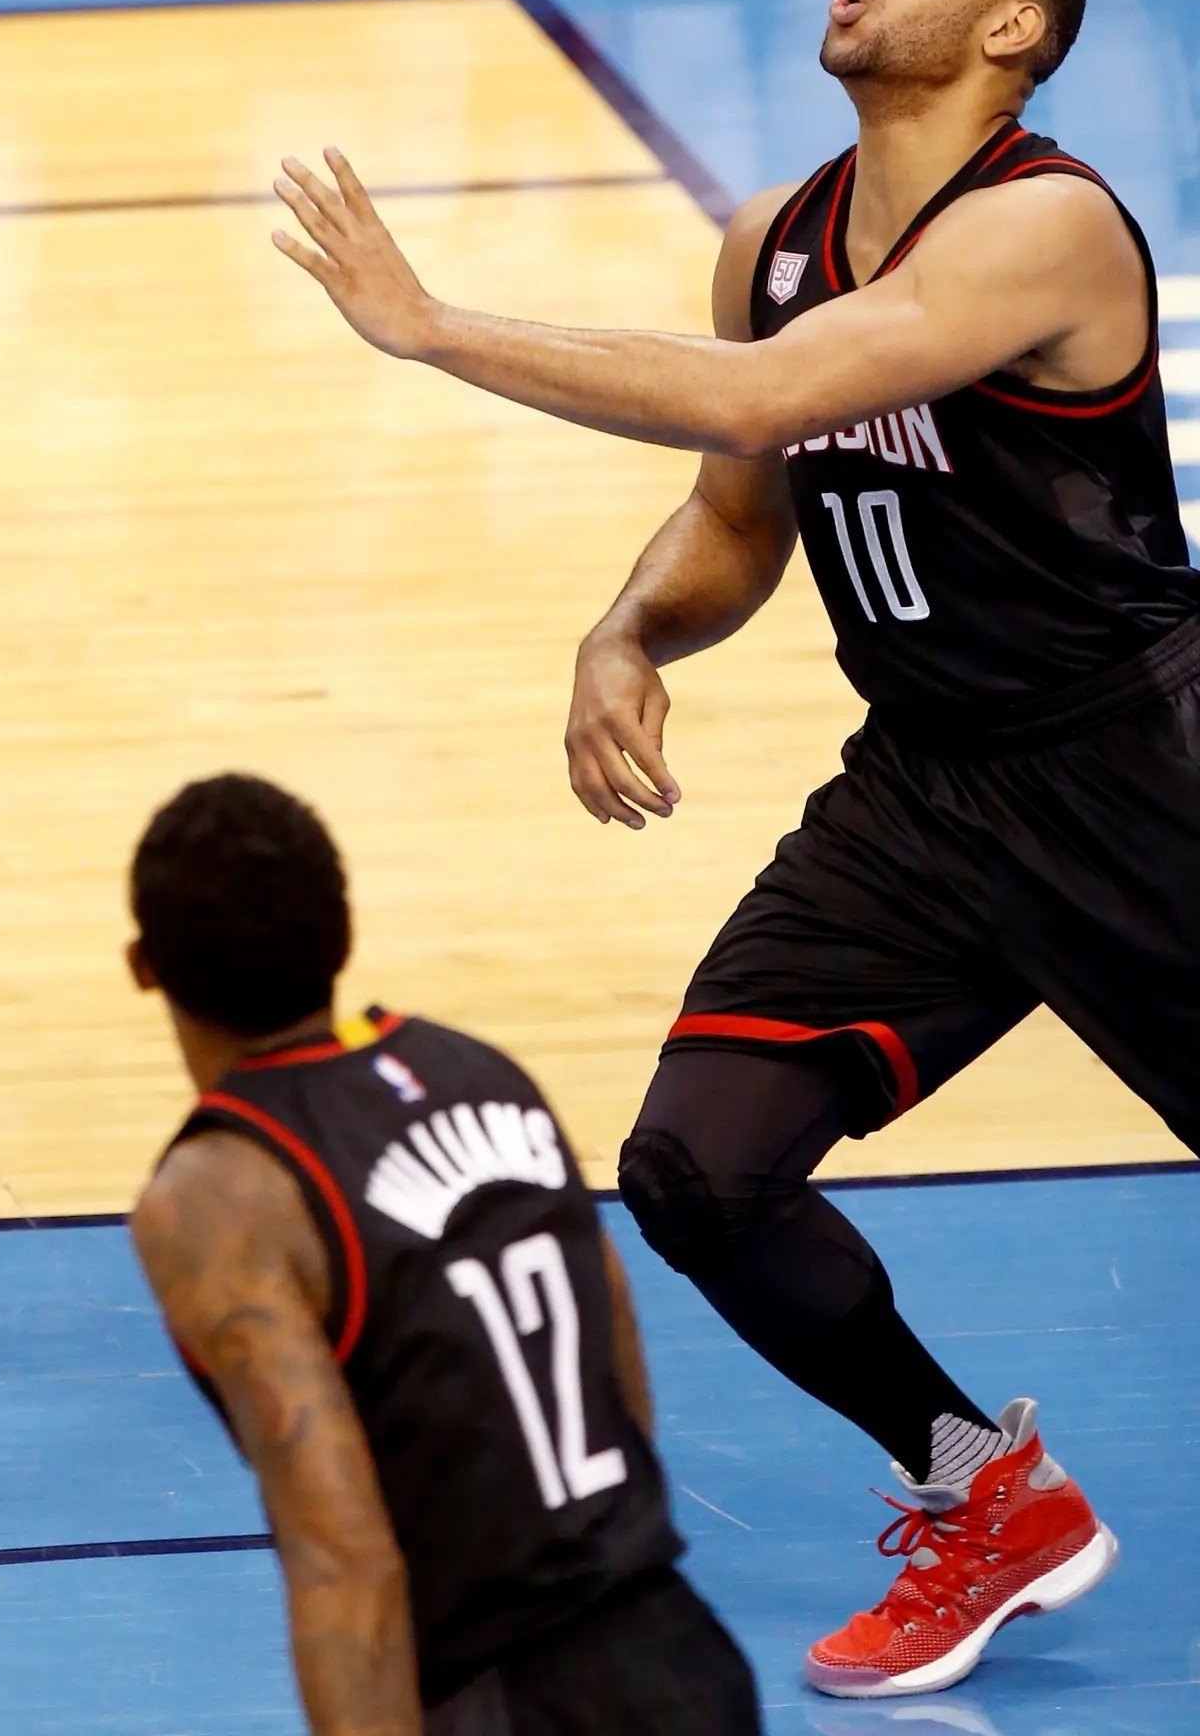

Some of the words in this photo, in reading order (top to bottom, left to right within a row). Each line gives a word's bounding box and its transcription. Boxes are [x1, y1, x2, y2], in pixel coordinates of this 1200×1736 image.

[774, 259, 799, 282] 50
[821, 489, 930, 623] 10
[364, 1101, 567, 1240] WILLIAMS
[444, 1231, 628, 1510] 12
